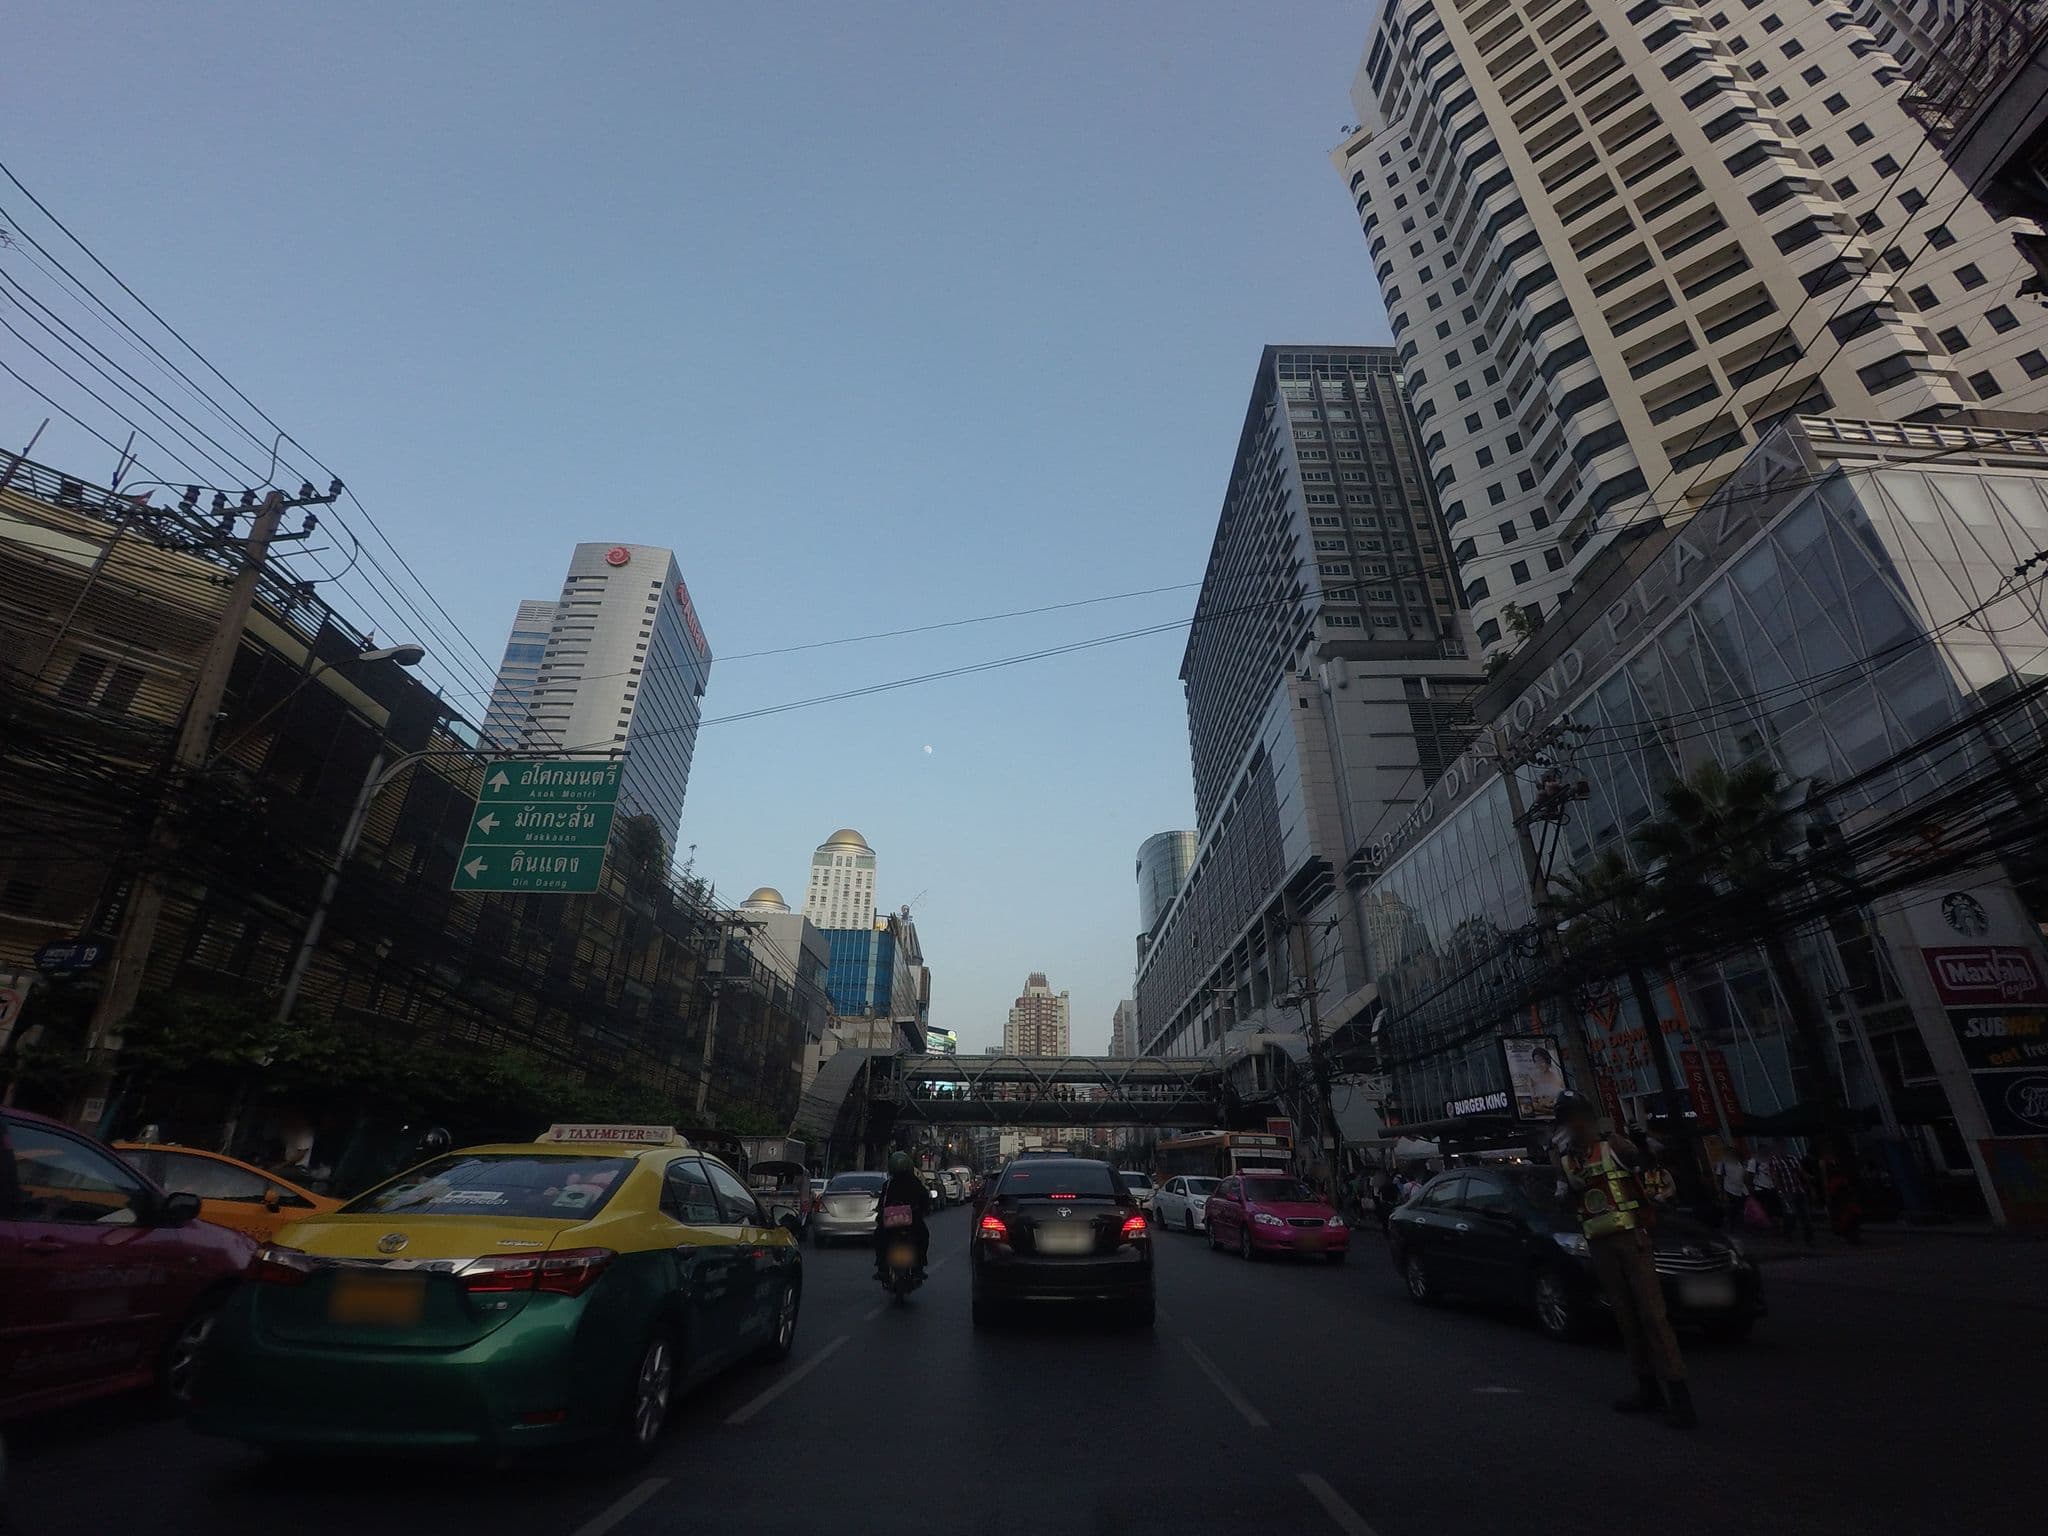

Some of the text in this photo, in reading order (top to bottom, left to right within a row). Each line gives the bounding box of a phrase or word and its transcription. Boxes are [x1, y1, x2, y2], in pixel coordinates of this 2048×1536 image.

[1370, 796, 1434, 866] GRAND
[1603, 448, 1804, 645] PLAZA
[520, 763, 618, 786] อโศกมนตรี
[529, 790, 596, 798] Asok Montri
[514, 804, 595, 828] มักกะสัน
[525, 833, 577, 841] Makkasan
[510, 850, 580, 873] ดินแดง
[512, 879, 568, 889] Din Daeng
[1453, 1091, 1508, 1116] BURGER KING
